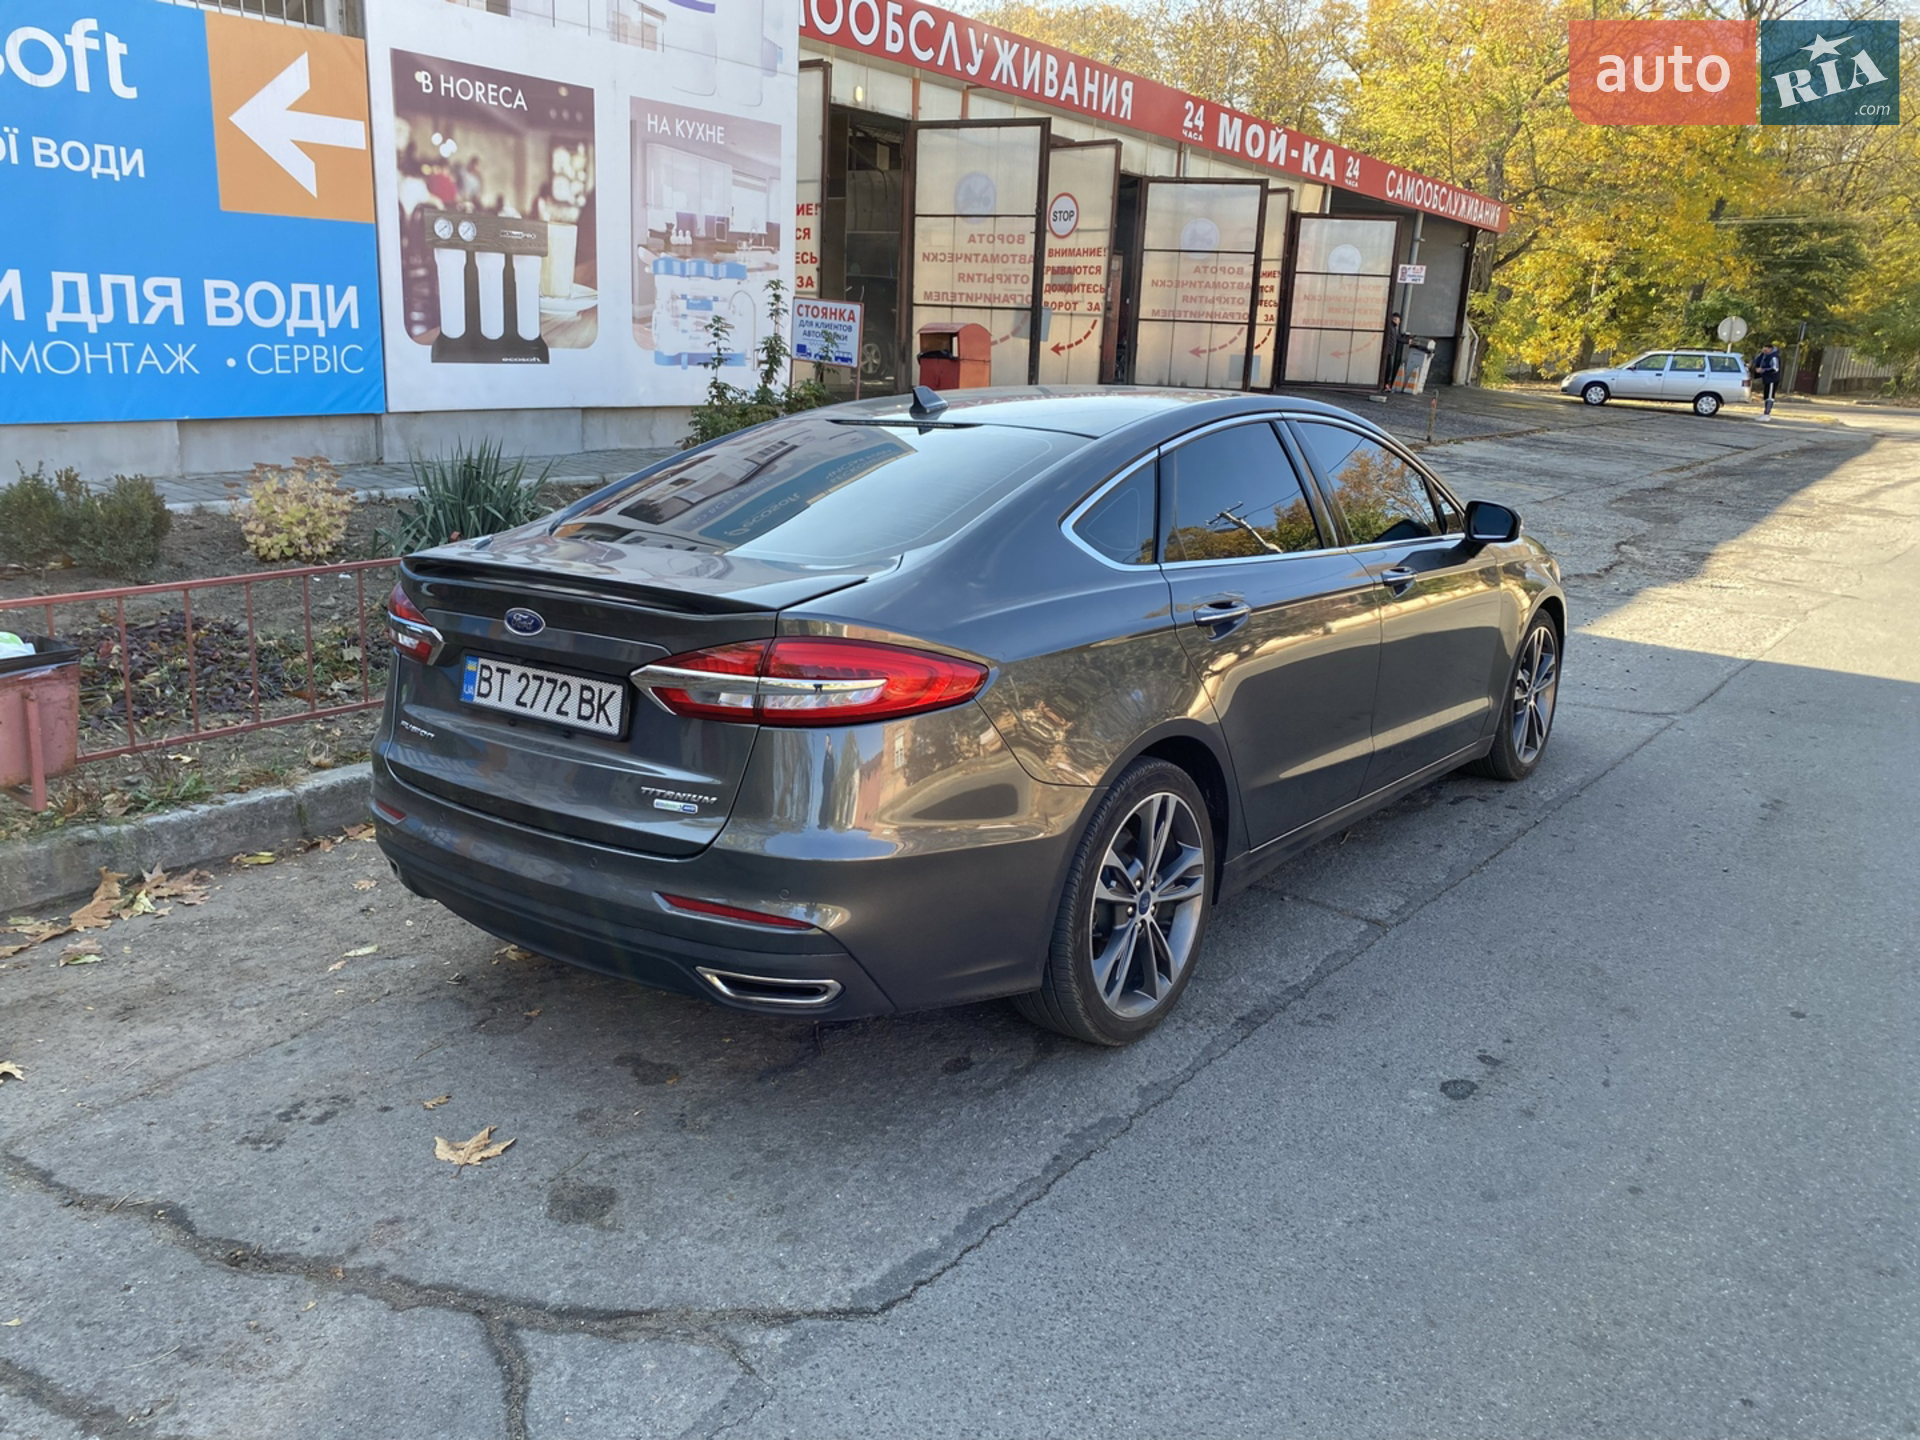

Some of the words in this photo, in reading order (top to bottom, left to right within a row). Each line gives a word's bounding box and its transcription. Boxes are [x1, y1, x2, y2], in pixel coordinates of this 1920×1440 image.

[0, 18, 138, 99] oft
[800, 0, 1134, 120] ООБСЛУЖИВАНИЯ
[440, 74, 528, 111] HORECA
[647, 113, 671, 137] НА
[676, 120, 725, 145] КУХНЕ
[1183, 101, 1204, 131] 24
[1182, 129, 1203, 142] ЧАСА
[1217, 112, 1336, 181] МОЙ-КА
[0, 126, 19, 165] Ї
[32, 136, 145, 181] ВОДИ
[1346, 156, 1360, 180] 24
[1386, 169, 1501, 228] САМООБСЛУЖИВАНИЯ
[1052, 210, 1075, 222] STOP
[1048, 247, 1107, 258] ВНИМАНИЕ!
[797, 276, 814, 288] ЗА
[1044, 265, 1102, 275] РЫВАЮТСЯ
[1044, 283, 1106, 295] ДОЖДИТЕСЬ
[46, 271, 185, 333] ДЛЯ
[203, 279, 360, 337] ВОДИ
[797, 304, 856, 323] СТОЯНКА
[799, 320, 813, 328] ДЛЯ
[815, 321, 852, 332] КЛИЕНТОВ
[1, 340, 200, 374] МОНТАЖ
[246, 344, 364, 374] СЕРВІС
[512, 612, 534, 630] Ford
[477, 664, 511, 702] BT
[515, 672, 572, 717] 2772
[577, 684, 616, 727] BK
[641, 786, 718, 804] TITANIUM
